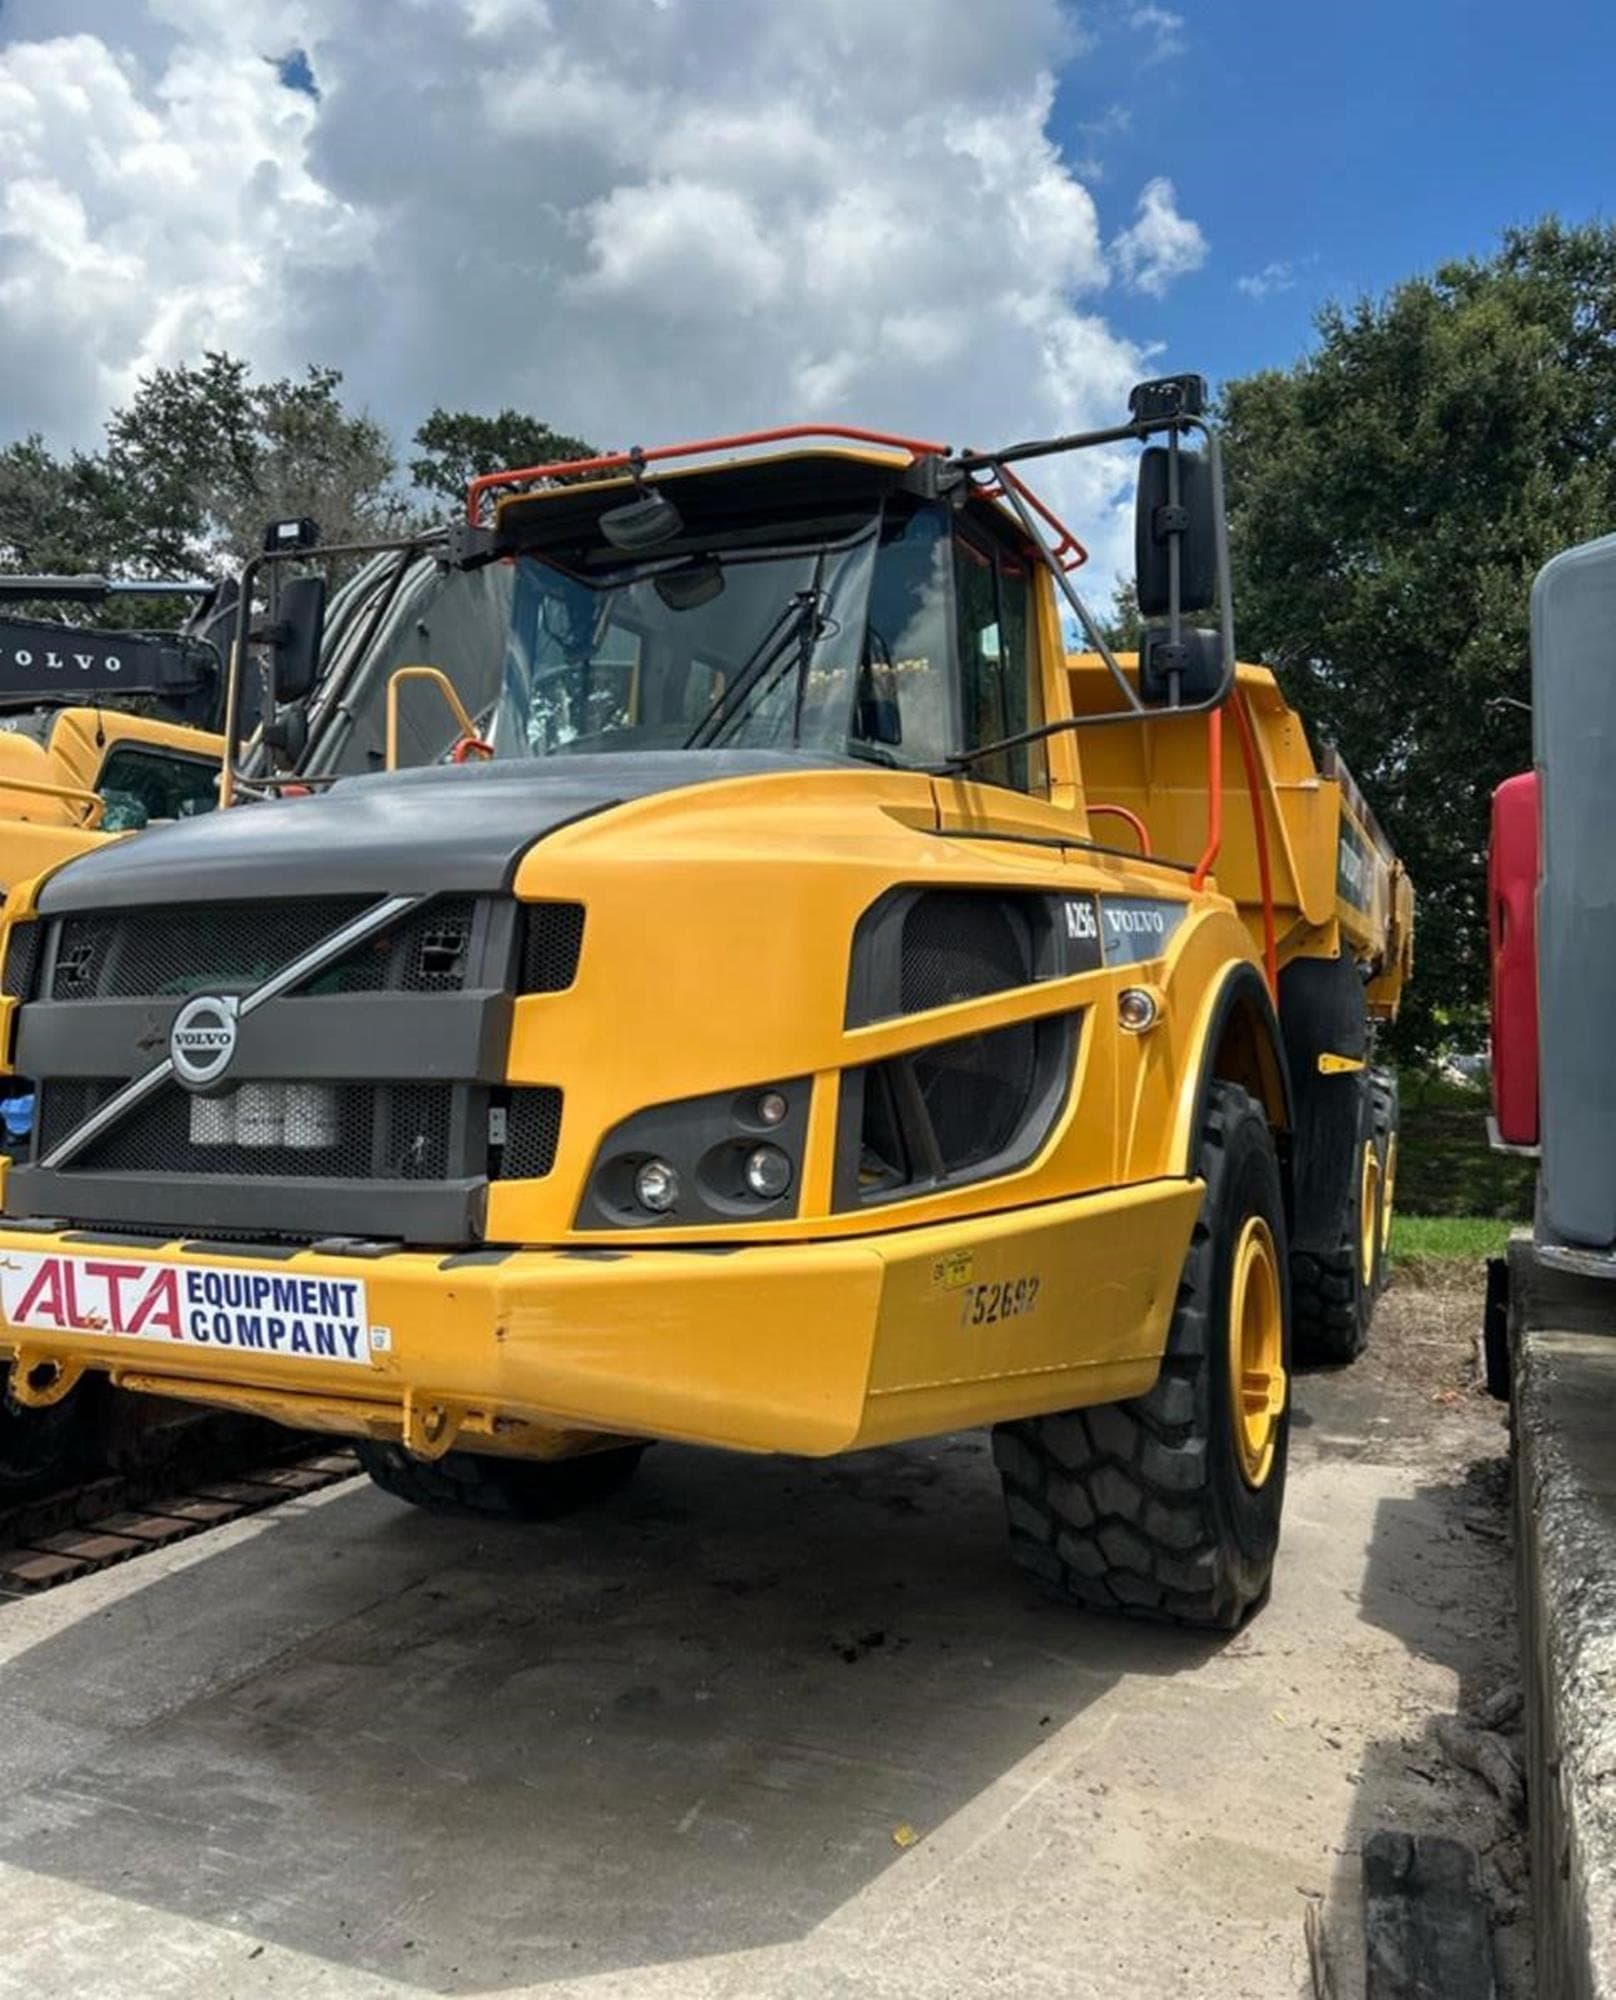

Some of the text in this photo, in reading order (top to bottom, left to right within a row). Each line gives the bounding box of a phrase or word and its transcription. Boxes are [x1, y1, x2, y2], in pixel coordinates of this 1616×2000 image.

[0, 649, 121, 672] OLVO
[1105, 909, 1164, 933] VOLVO
[175, 1033, 231, 1045] VOLVO
[12, 1258, 183, 1340] ALTA
[186, 1271, 358, 1318] EQUIPMENT
[190, 1310, 360, 1358] COMPANY
